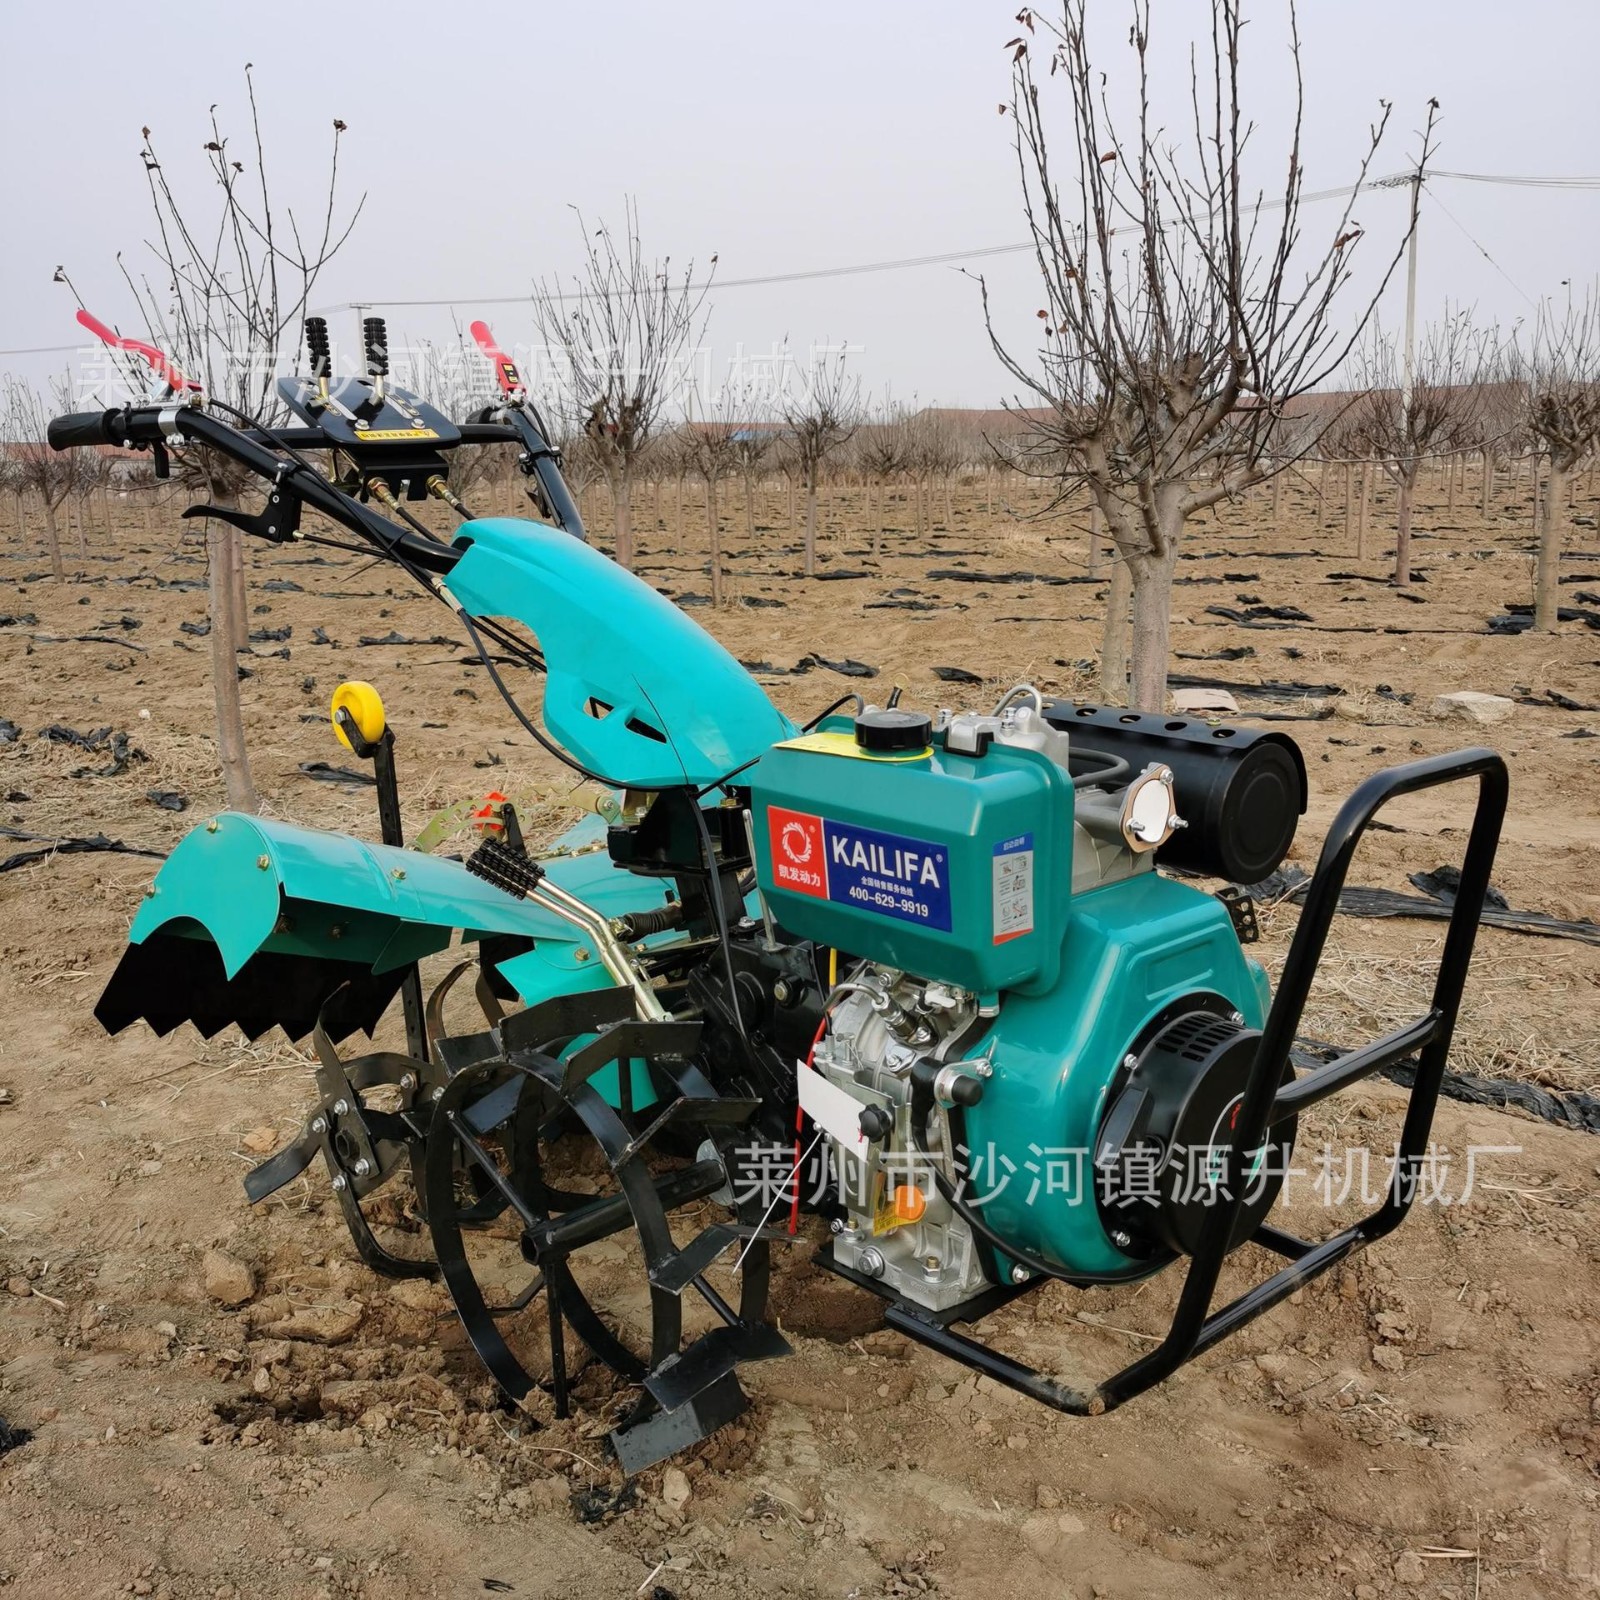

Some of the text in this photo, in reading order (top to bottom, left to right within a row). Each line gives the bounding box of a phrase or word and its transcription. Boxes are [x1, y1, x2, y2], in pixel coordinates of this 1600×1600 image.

[832, 835, 940, 888] KAILIFA
[778, 864, 821, 887] 凯发动力
[861, 876, 914, 897] 全国销售服务热线
[849, 886, 929, 917] 400-629-9919
